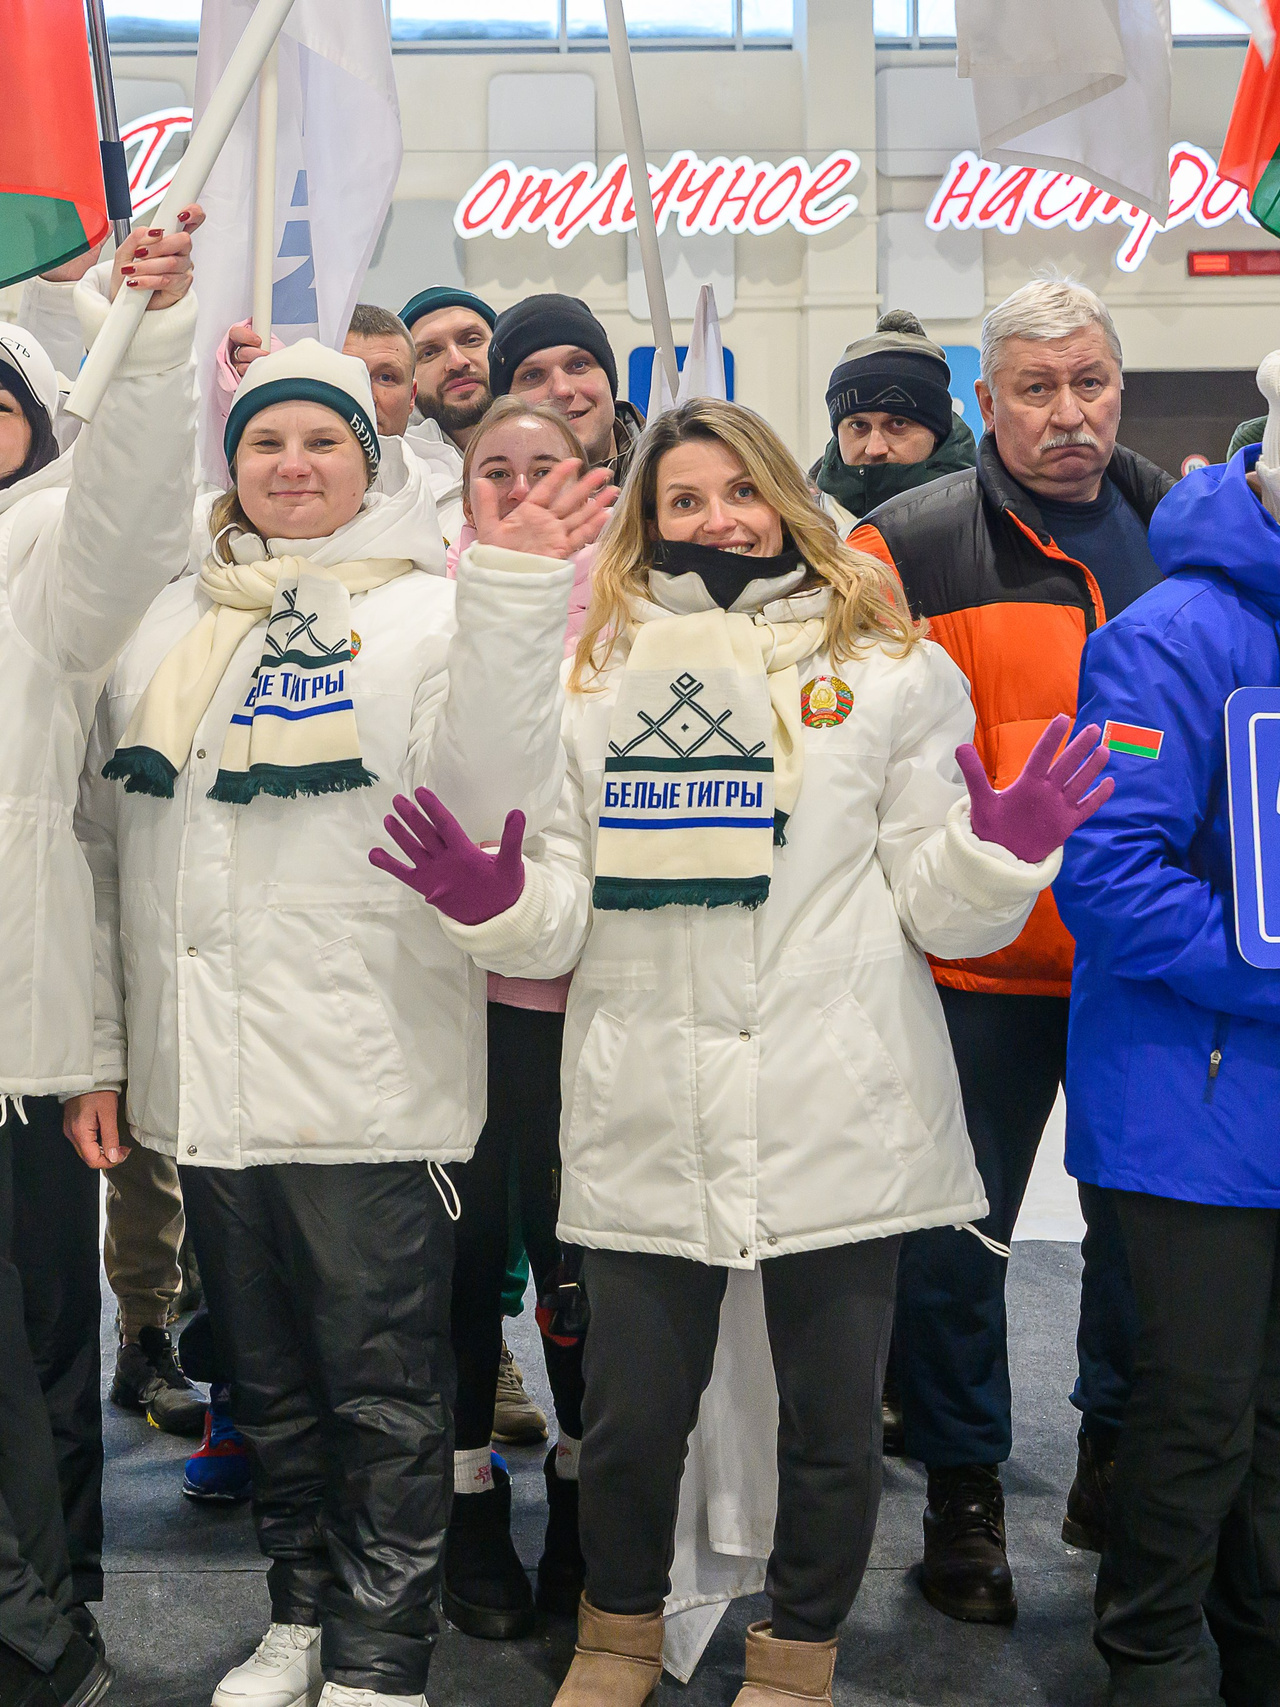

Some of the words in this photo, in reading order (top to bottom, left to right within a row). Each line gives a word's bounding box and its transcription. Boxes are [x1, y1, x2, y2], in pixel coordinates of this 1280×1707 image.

[280, 669, 344, 702] ТИГРЫ
[604, 781, 681, 810] БЕЛЫЕ
[686, 780, 763, 809] ТИГРЫ
